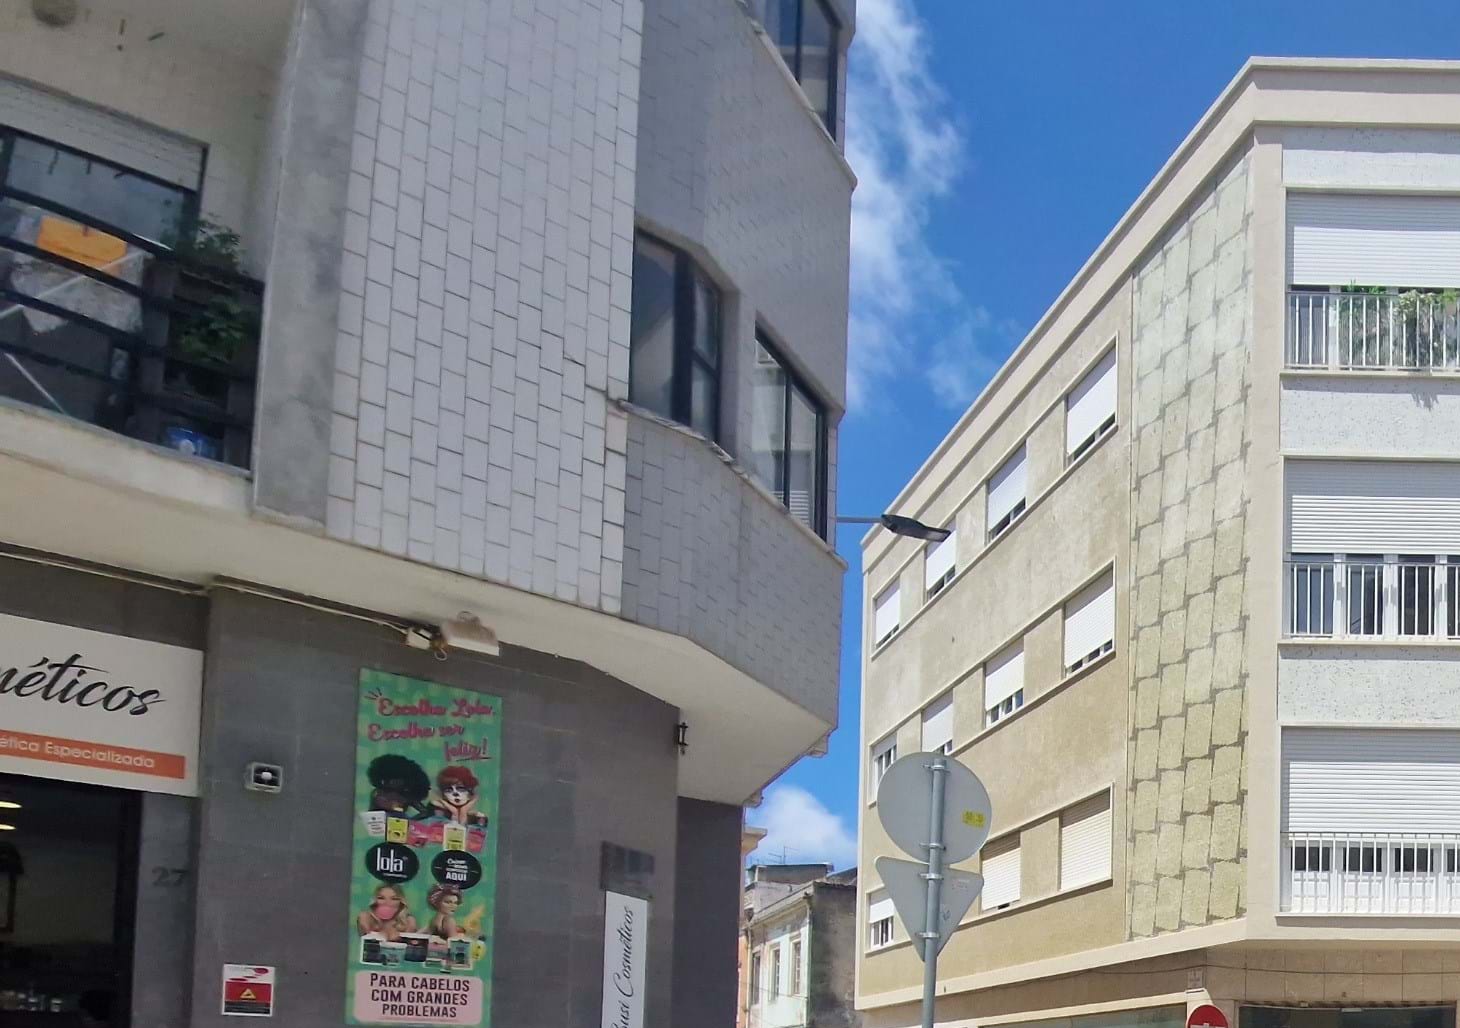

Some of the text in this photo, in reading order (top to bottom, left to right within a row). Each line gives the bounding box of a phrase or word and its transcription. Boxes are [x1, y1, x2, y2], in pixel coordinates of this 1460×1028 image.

[44, 741, 156, 769] Especializada
[376, 847, 404, 873] lola
[152, 865, 188, 888] 27
[445, 871, 467, 881] AQUI
[612, 905, 635, 999] Cosméticos
[370, 972, 470, 992] PARA CABELOS
[371, 989, 468, 1006] COM GRANDES
[382, 1003, 457, 1018] PROBLEMAS
